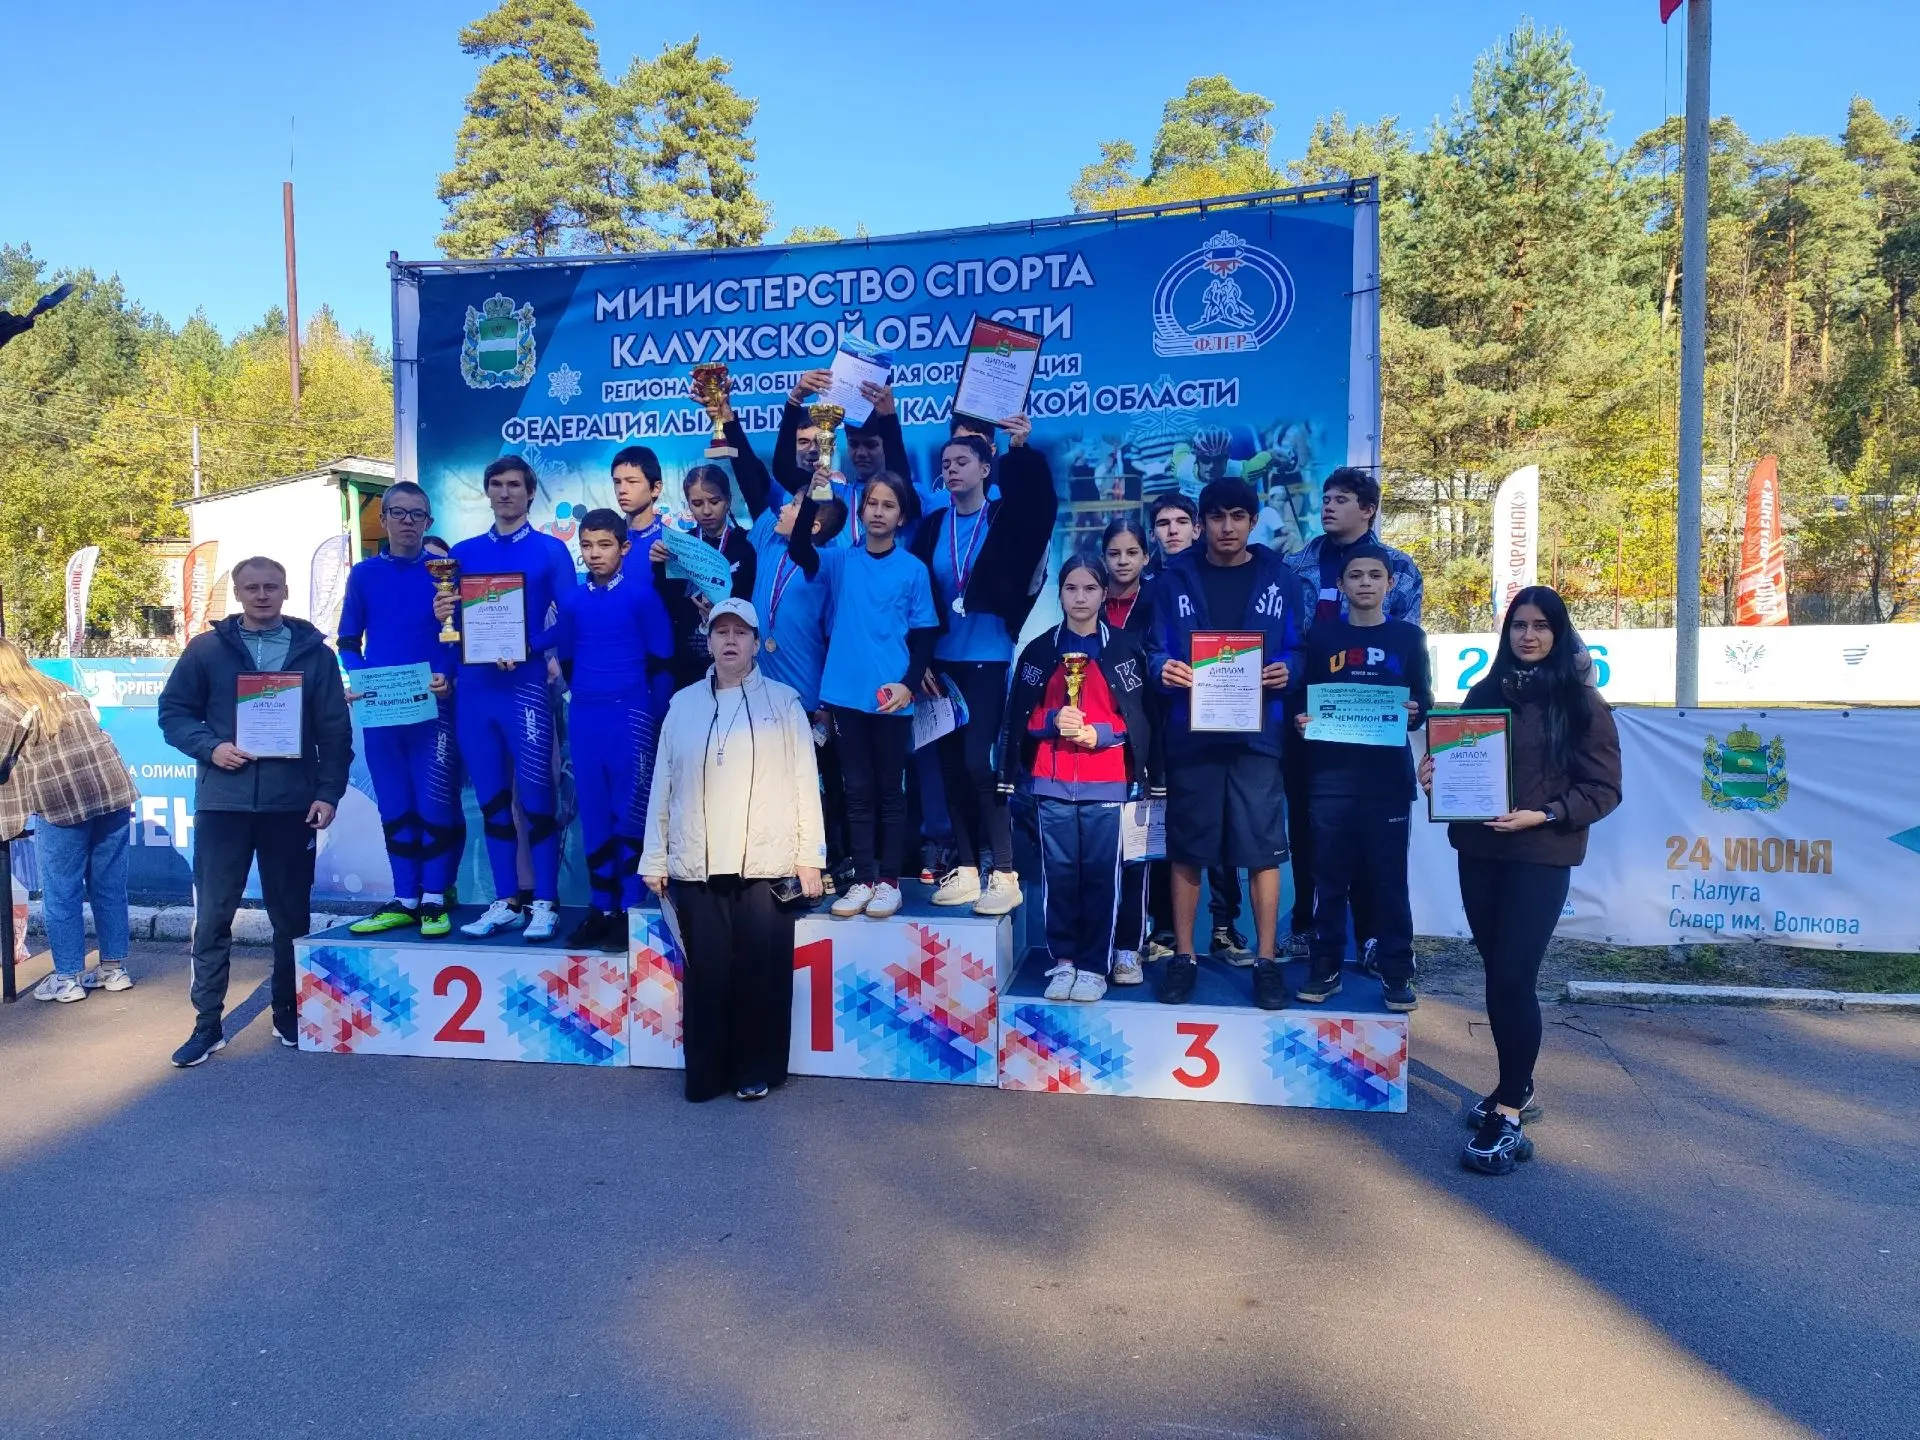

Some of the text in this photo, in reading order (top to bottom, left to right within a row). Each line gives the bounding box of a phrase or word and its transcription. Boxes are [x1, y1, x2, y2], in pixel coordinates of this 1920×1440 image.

[597, 254, 1094, 322] МИНИСТЕРСТВО СПОРТА
[984, 356, 1017, 371] ДИПЛОМ
[604, 375, 753, 400] РЕГИОНААЯ
[503, 414, 660, 444] ФЕДЕРАЦИЯ
[1095, 379, 1238, 411] ОБЛАСТИ
[1509, 490, 1528, 577] «ОРЛЕНОК»
[1209, 667, 1245, 675] ДИПЛОМ
[1335, 714, 1380, 722] ЧЕМПИОН
[1449, 751, 1488, 760] ДИПЛОМ
[1666, 835, 1832, 874] 24 ИЮНЯ
[1672, 878, 1760, 905] г. Калуга
[1668, 908, 1860, 934] Сквер им. Волкова
[432, 965, 486, 1043] 2
[793, 938, 834, 1052] 1
[1172, 1022, 1220, 1089] 3
